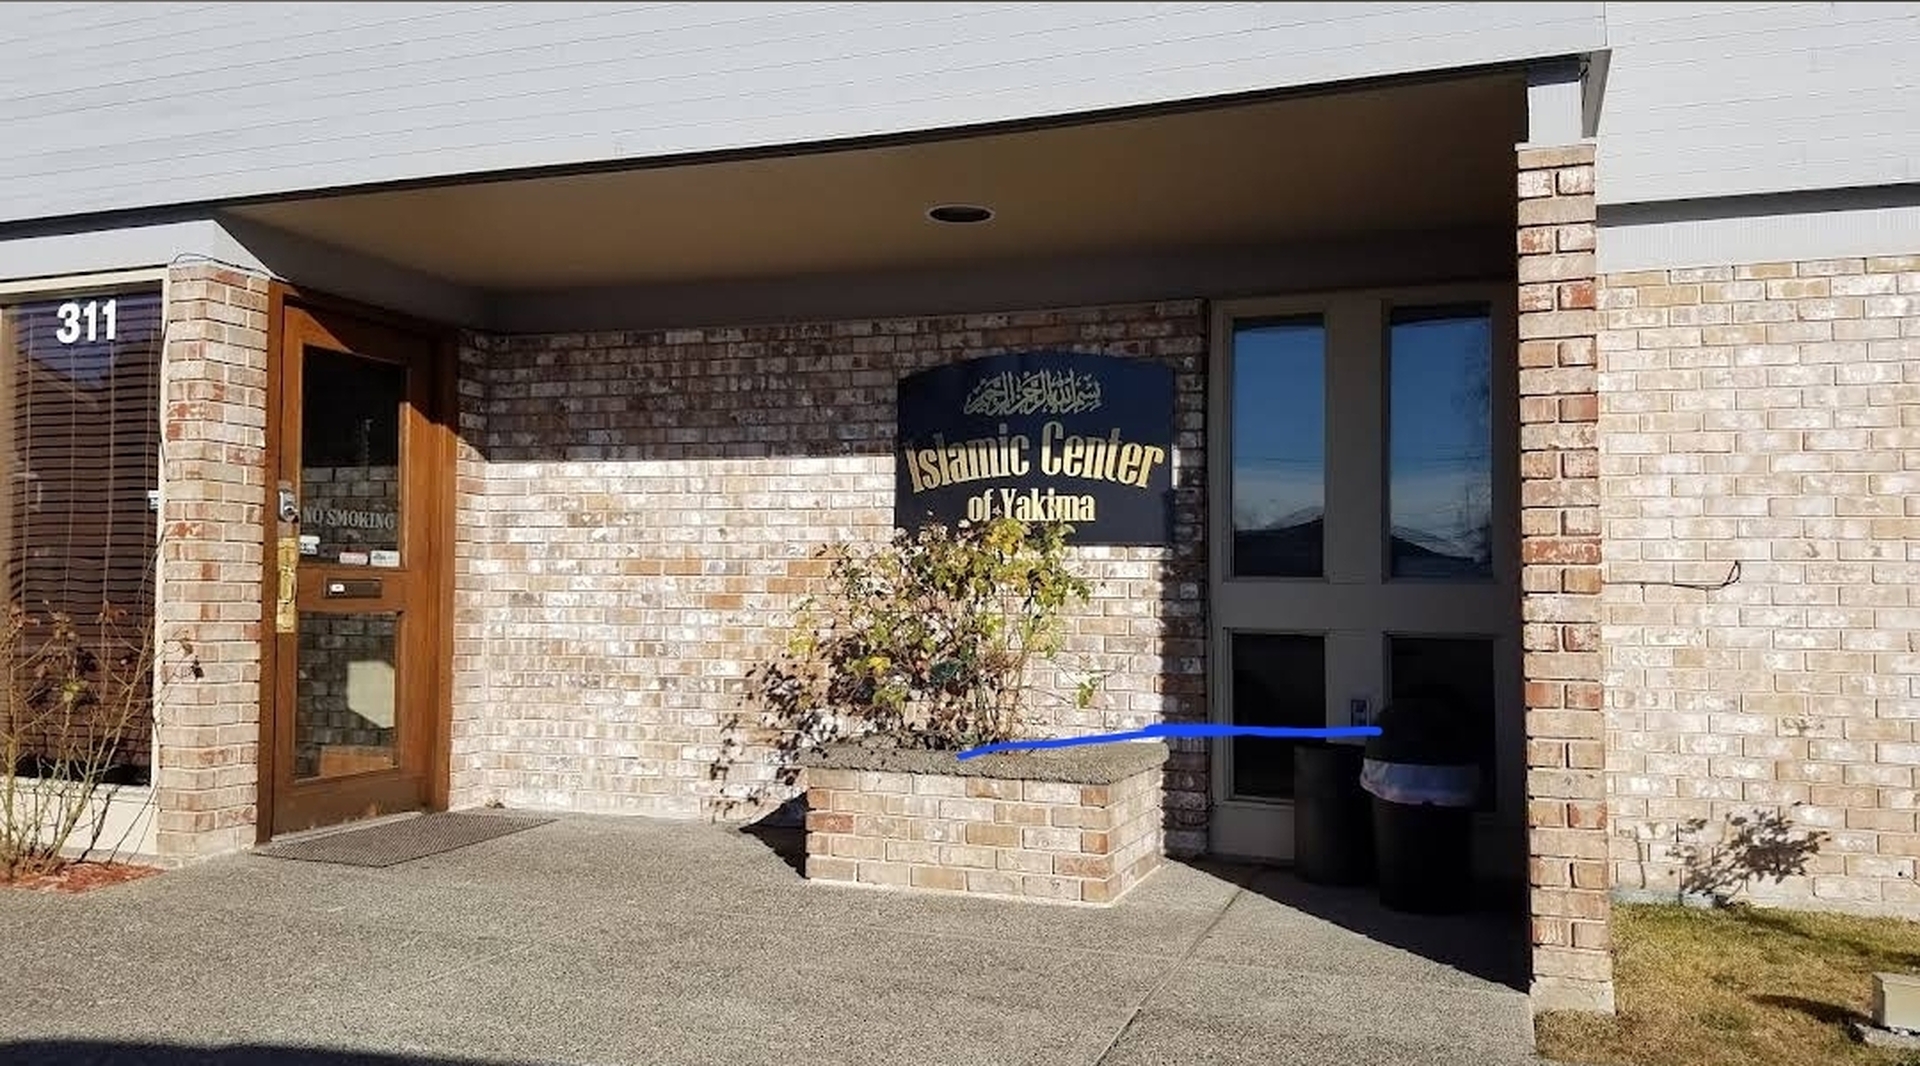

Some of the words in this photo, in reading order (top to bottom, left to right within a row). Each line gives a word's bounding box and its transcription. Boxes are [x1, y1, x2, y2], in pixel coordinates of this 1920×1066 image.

[56, 299, 116, 343] 311
[905, 424, 1030, 493] Islamic
[1041, 421, 1164, 488] Center
[303, 506, 323, 525] NO
[326, 508, 395, 529] SMOKING
[967, 489, 995, 522] of
[1000, 488, 1096, 522] Yakima
